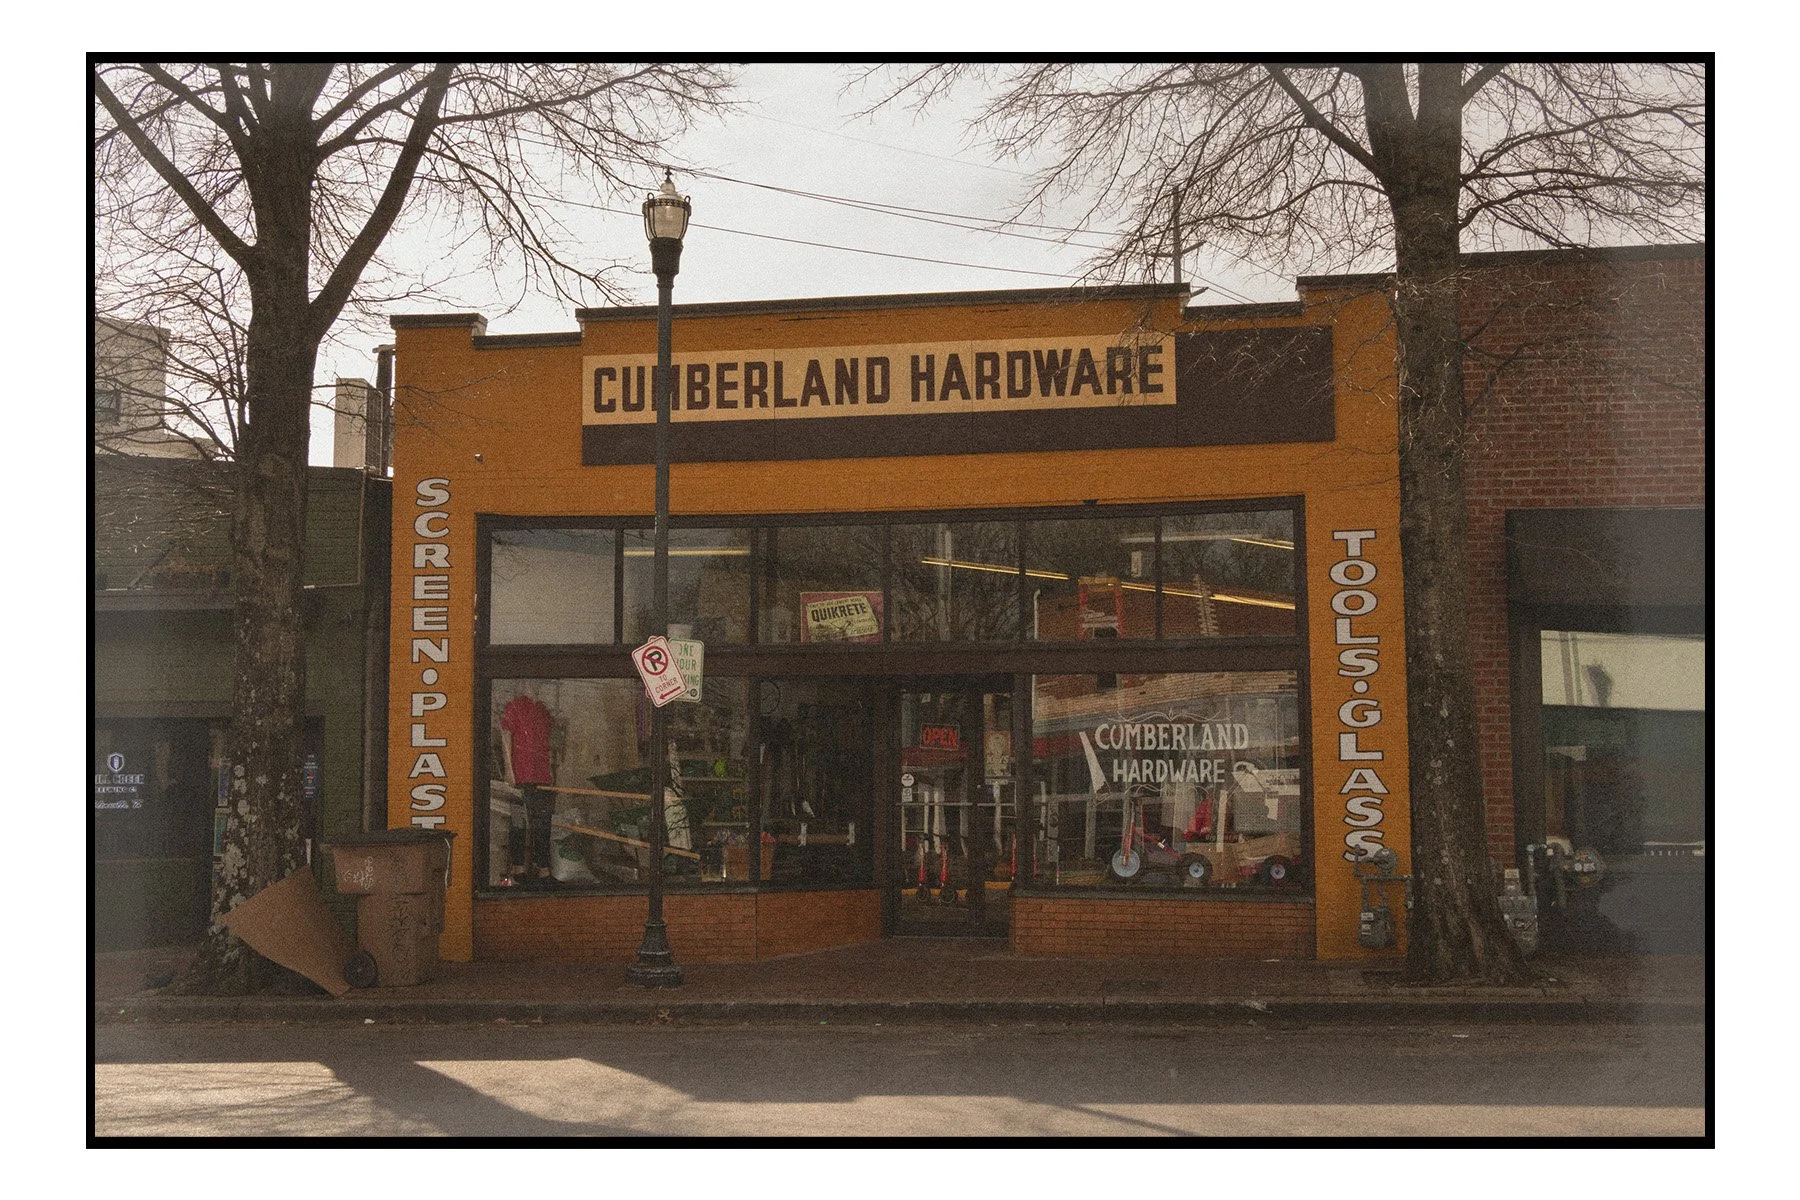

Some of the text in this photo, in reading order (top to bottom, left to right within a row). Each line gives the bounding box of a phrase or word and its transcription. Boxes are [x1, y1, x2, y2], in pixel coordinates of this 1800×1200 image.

[910, 344, 1164, 402] HARDWARE
[411, 477, 452, 664] SCREEN
[811, 602, 868, 623] QUIKRETE
[677, 658, 696, 671] OUR
[655, 677, 679, 694] CORNER
[659, 674, 668, 682] TO
[1328, 529, 1391, 863] TOOLS GLASS
[921, 726, 958, 748] OPEN
[1094, 723, 1249, 751] CUMBERLAND
[1112, 759, 1225, 783] HARDWARE
